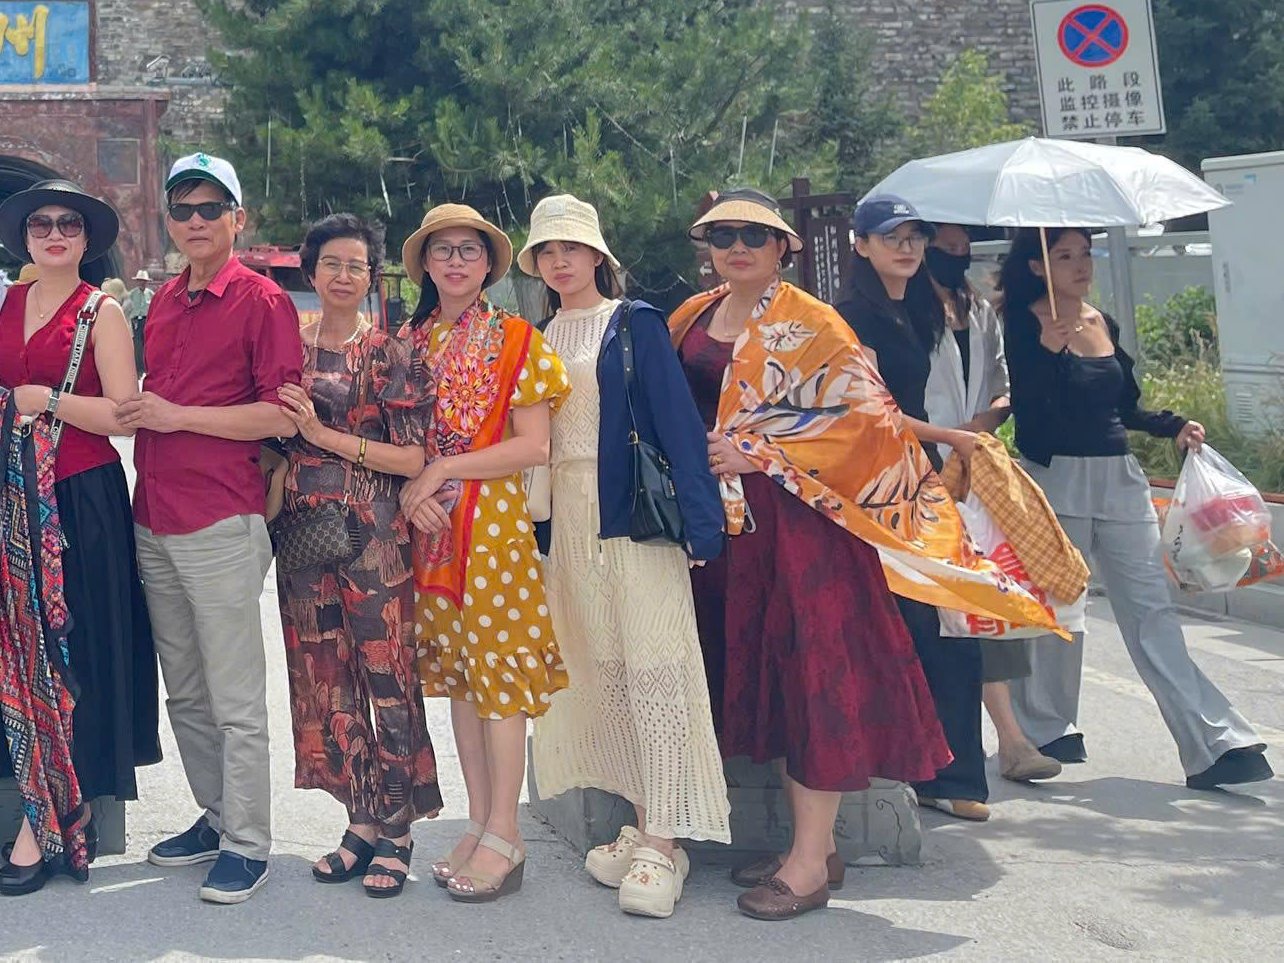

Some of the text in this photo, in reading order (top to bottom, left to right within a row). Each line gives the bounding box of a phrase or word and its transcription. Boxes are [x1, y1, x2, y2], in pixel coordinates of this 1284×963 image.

[1057, 71, 1141, 93] 此路段
[1060, 90, 1143, 112] 监控摄像
[1061, 110, 1146, 131] 禁止停车
